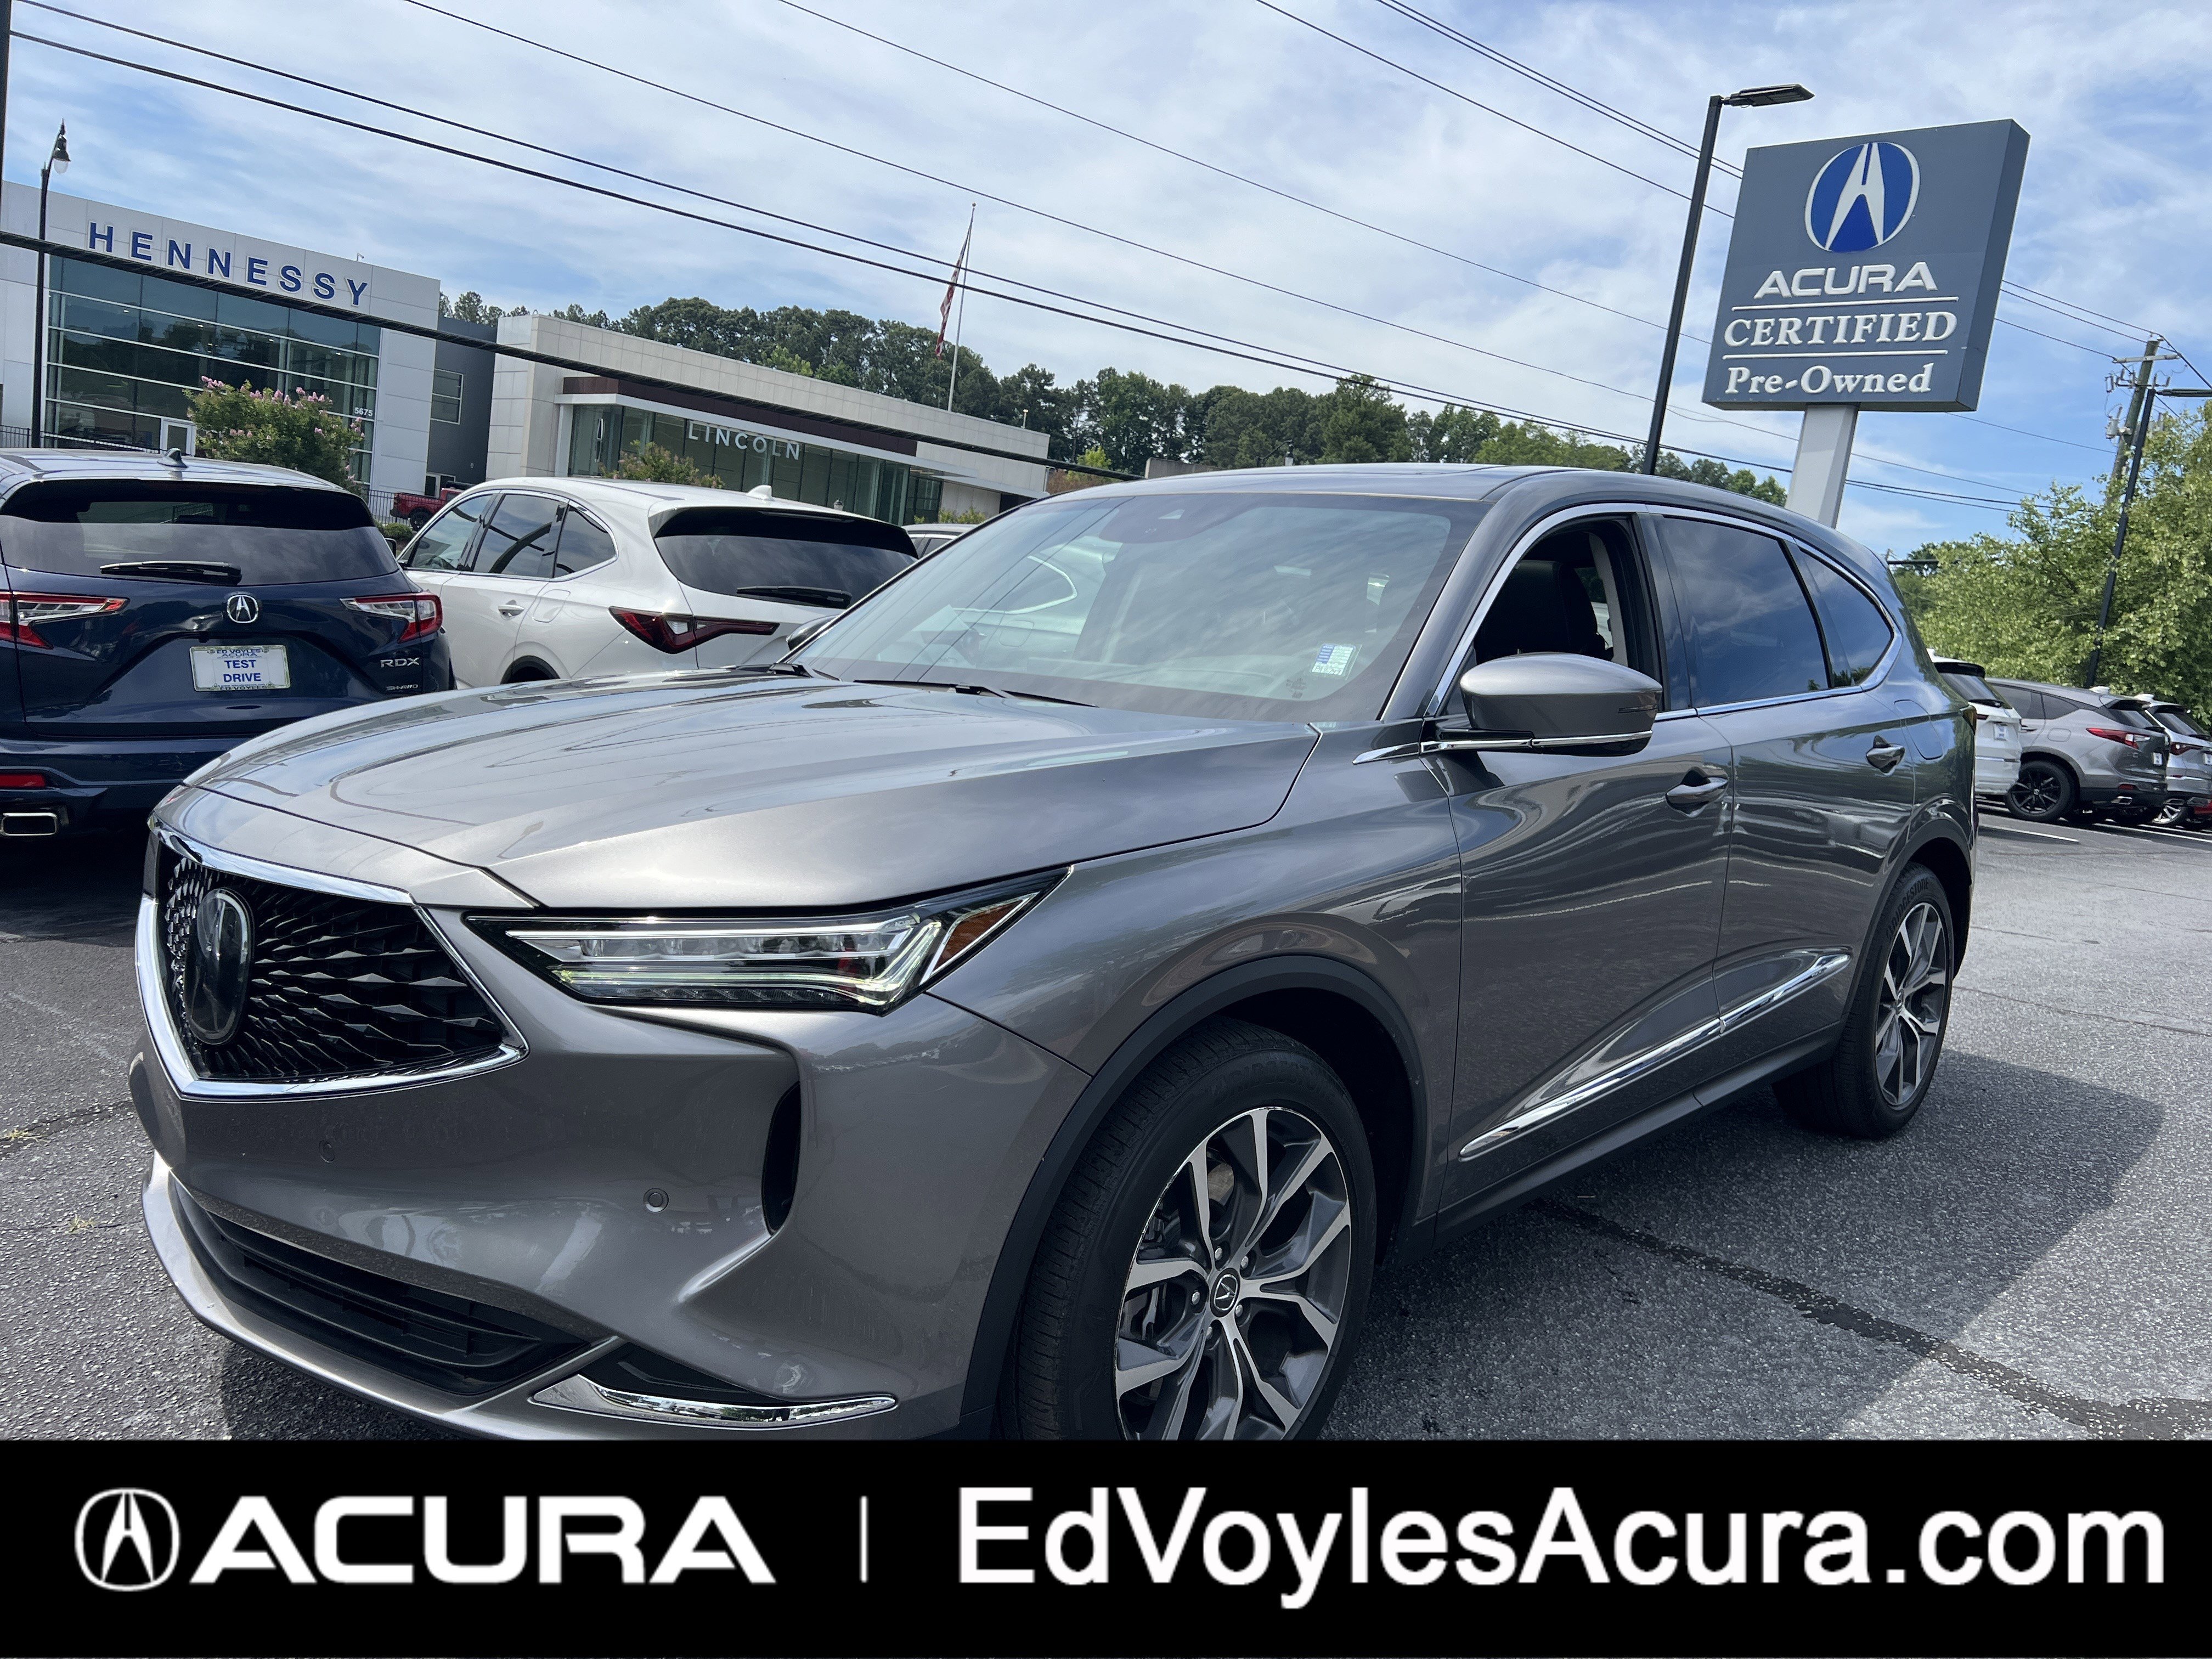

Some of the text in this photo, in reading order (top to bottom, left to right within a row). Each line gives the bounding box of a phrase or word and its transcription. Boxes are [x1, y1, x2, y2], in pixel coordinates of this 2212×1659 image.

[88, 222, 369, 306] HENNESSY
[1754, 262, 1938, 299] ACURA
[1724, 312, 1958, 347] CERTIFIED
[1724, 363, 1934, 394] Pre-Owned
[354, 407, 373, 416] 5675
[689, 421, 800, 460] LINCOLN
[223, 673, 262, 682] DRIVE
[224, 659, 256, 669] TEST
[380, 657, 420, 668] RDX
